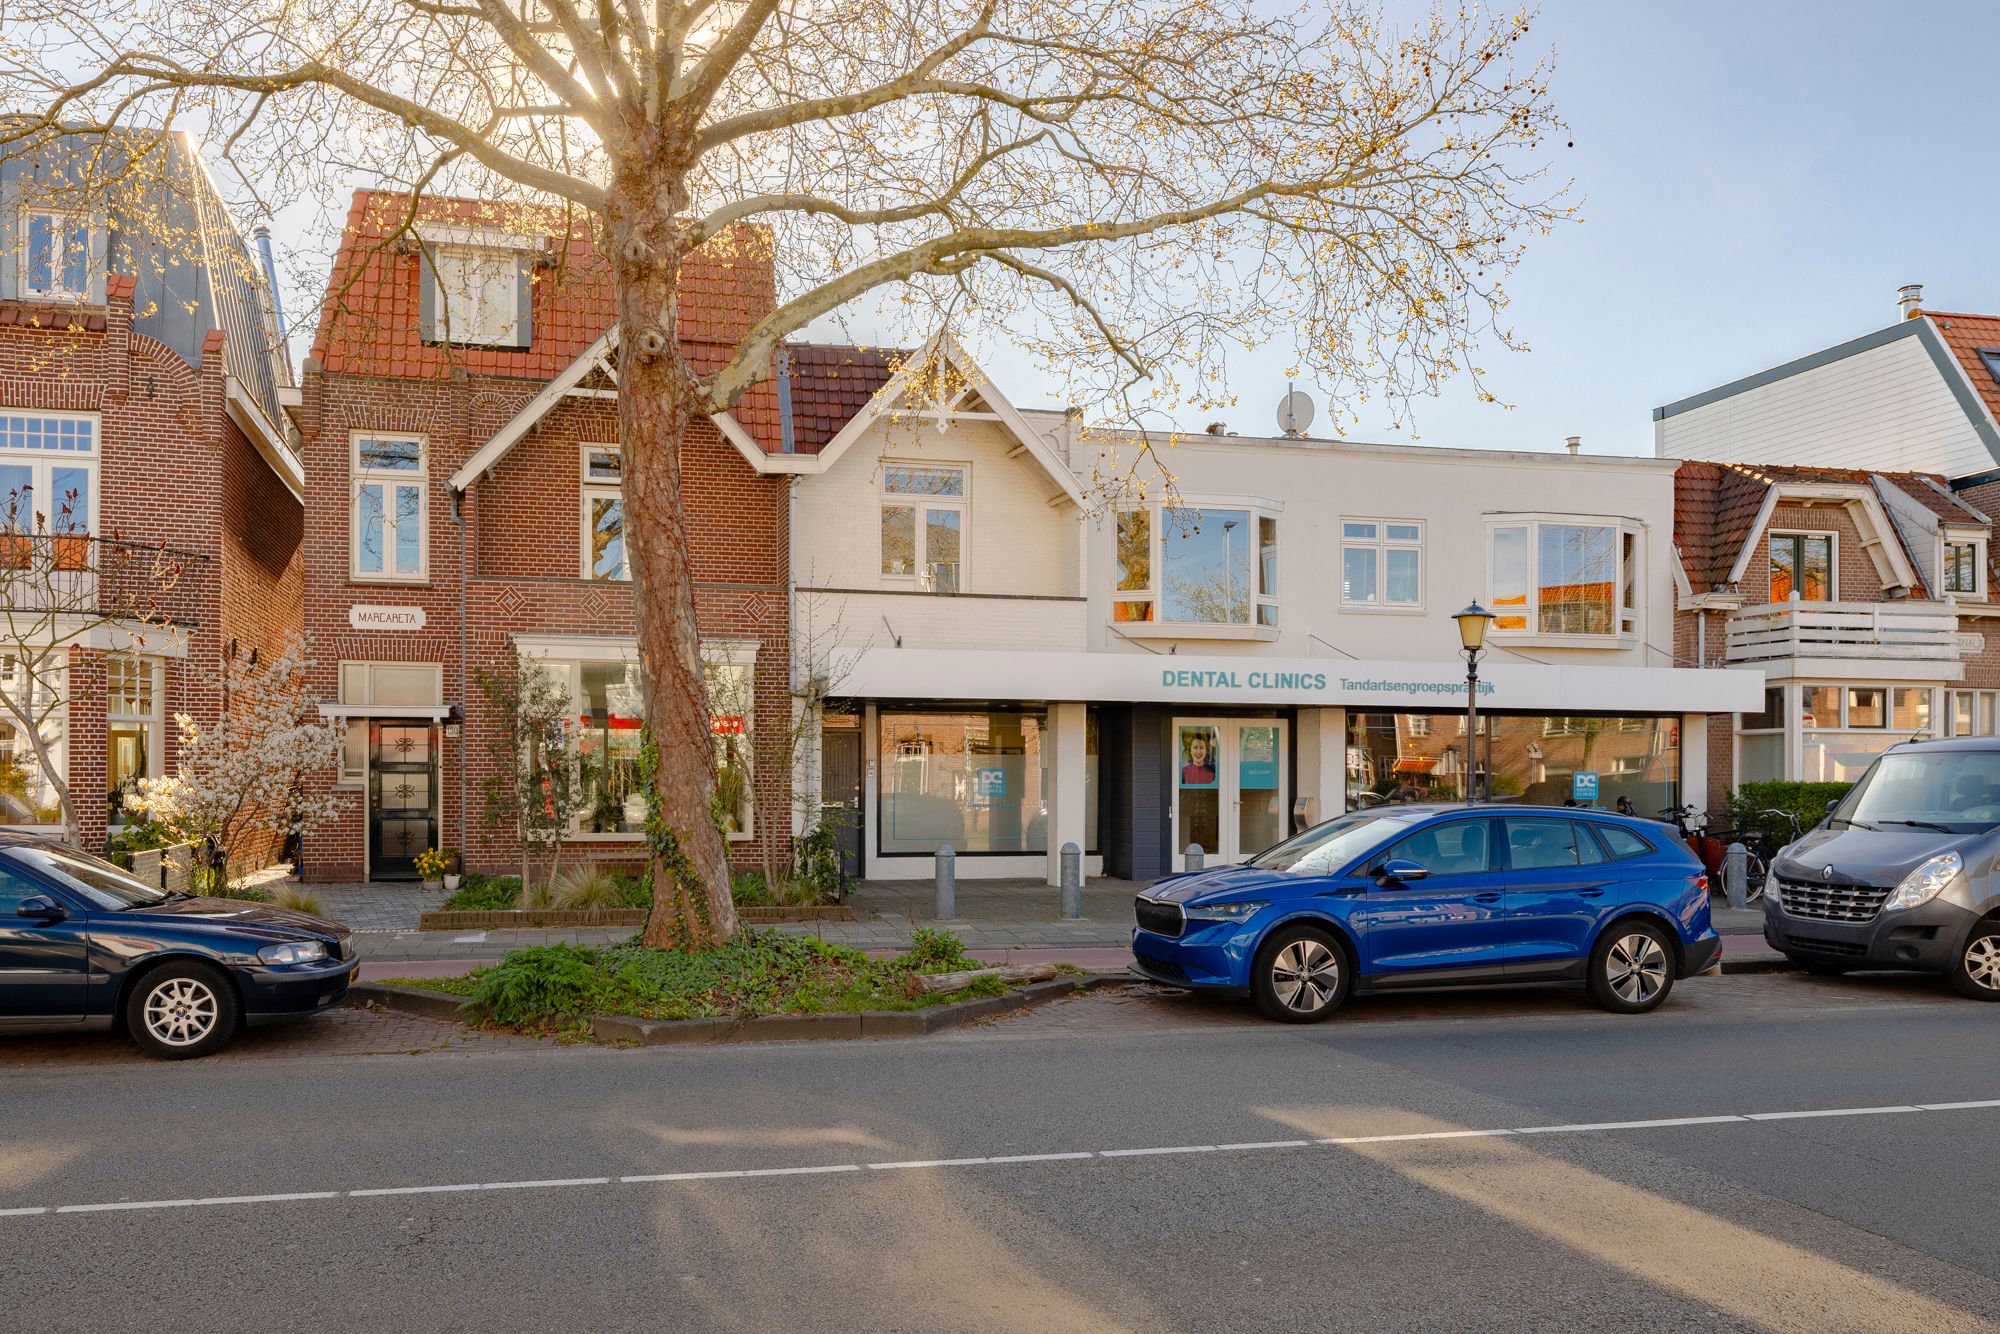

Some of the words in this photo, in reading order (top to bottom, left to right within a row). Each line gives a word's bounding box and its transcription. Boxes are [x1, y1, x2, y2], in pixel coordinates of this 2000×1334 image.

[358, 612, 417, 624] MARGARETA
[1162, 670, 1242, 689] DENTAL
[1248, 672, 1326, 690] CLINICS
[1339, 678, 1495, 696] Tandartsengroepspratijk
[981, 771, 1003, 784] DC
[1576, 774, 1596, 787] DC
